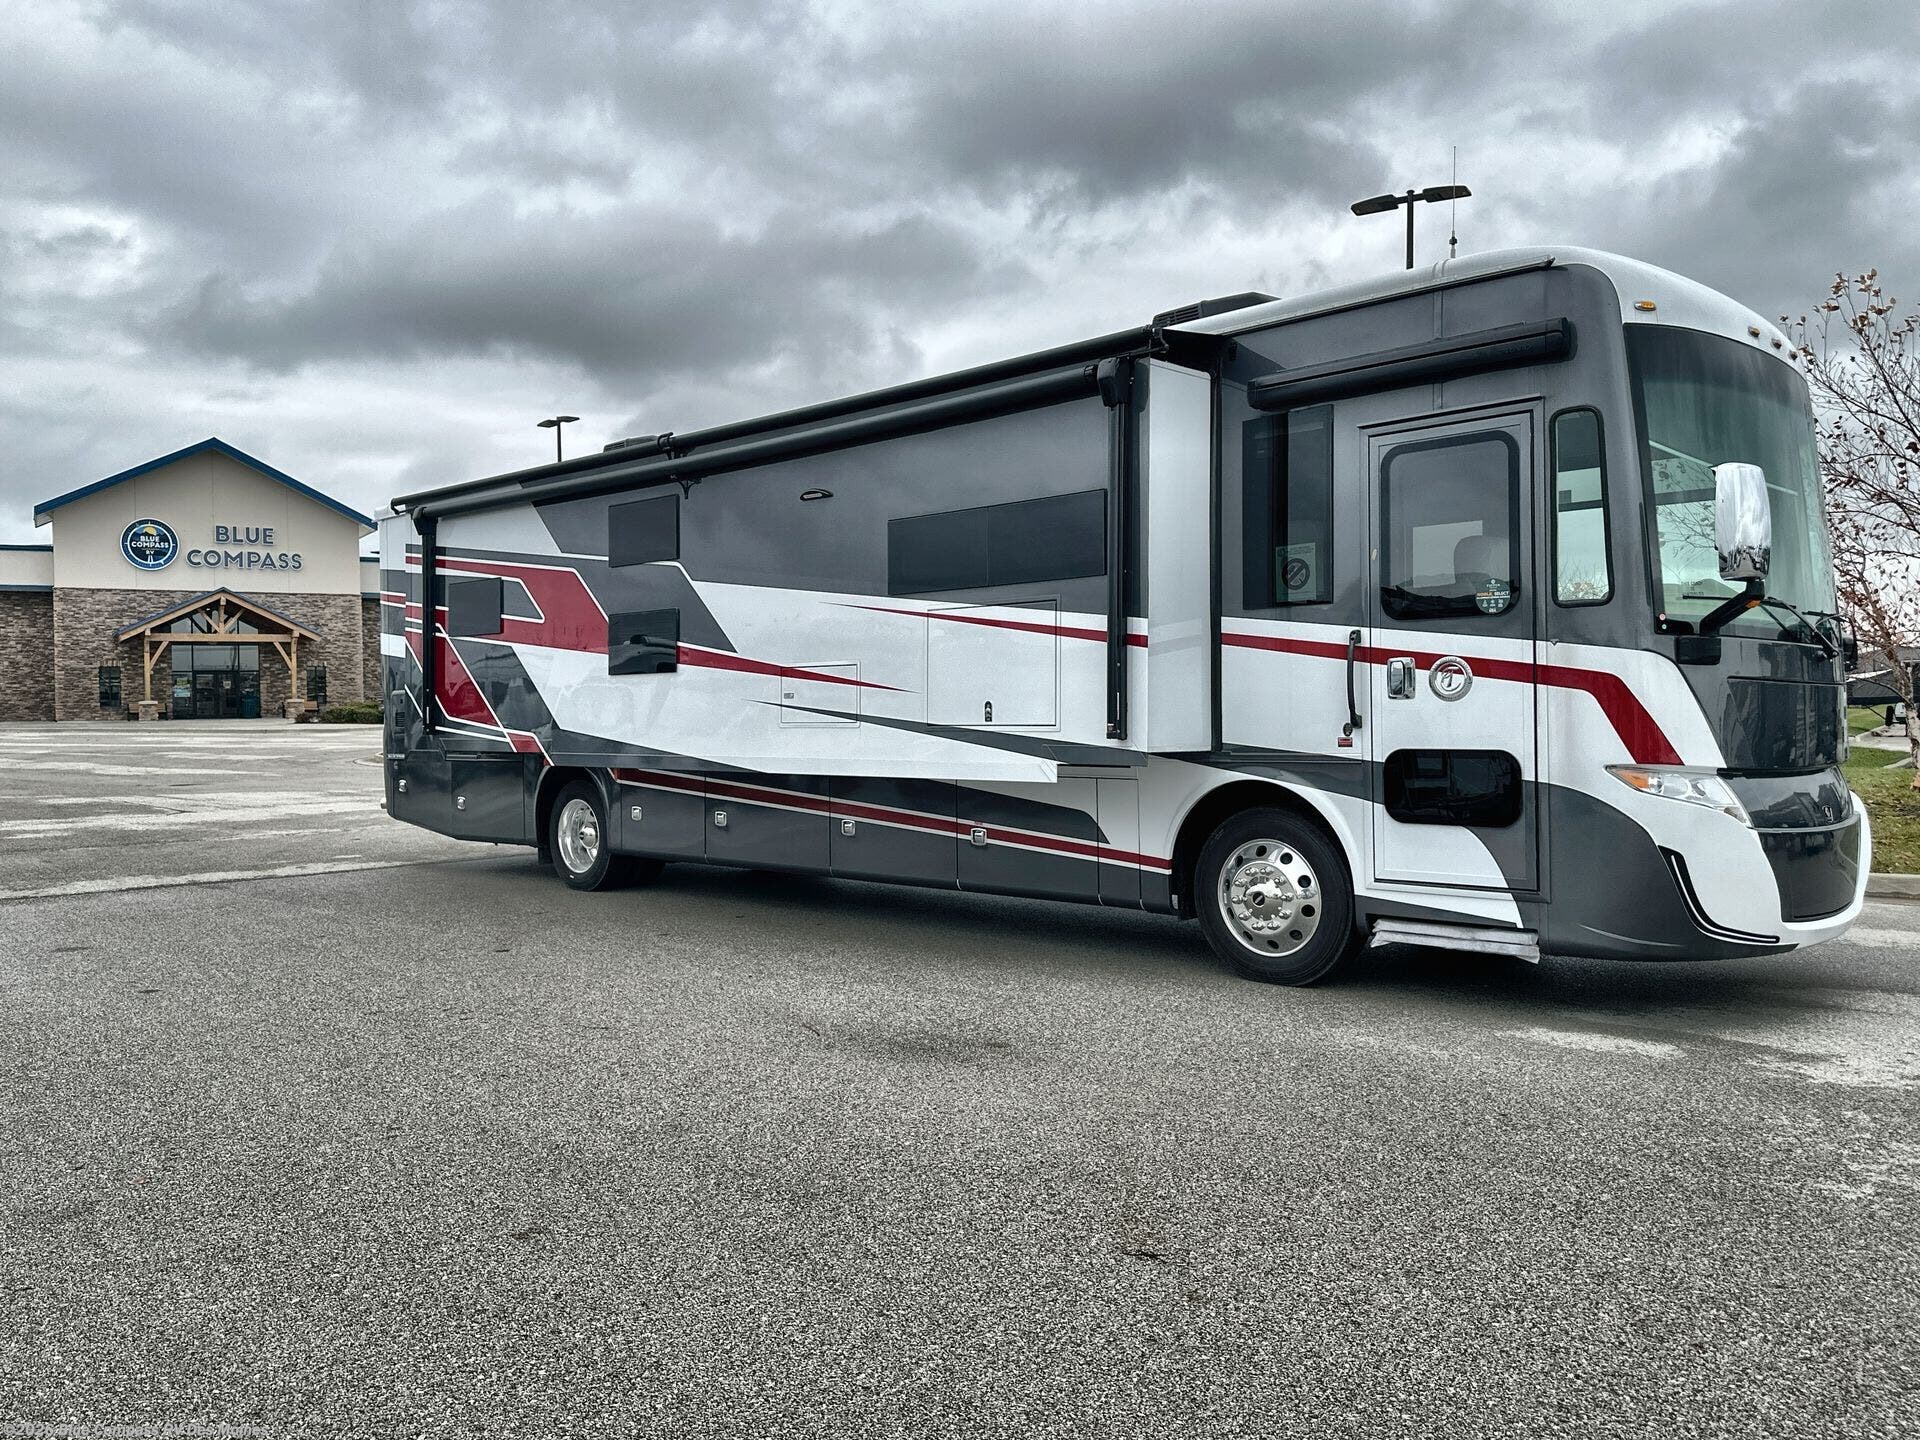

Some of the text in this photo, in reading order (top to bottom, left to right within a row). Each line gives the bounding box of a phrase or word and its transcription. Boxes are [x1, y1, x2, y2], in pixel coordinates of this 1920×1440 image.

[140, 535, 160, 543] BLUE
[215, 525, 274, 545] BLUE
[131, 541, 169, 549] COMPASS
[187, 549, 303, 570] COMPASS
